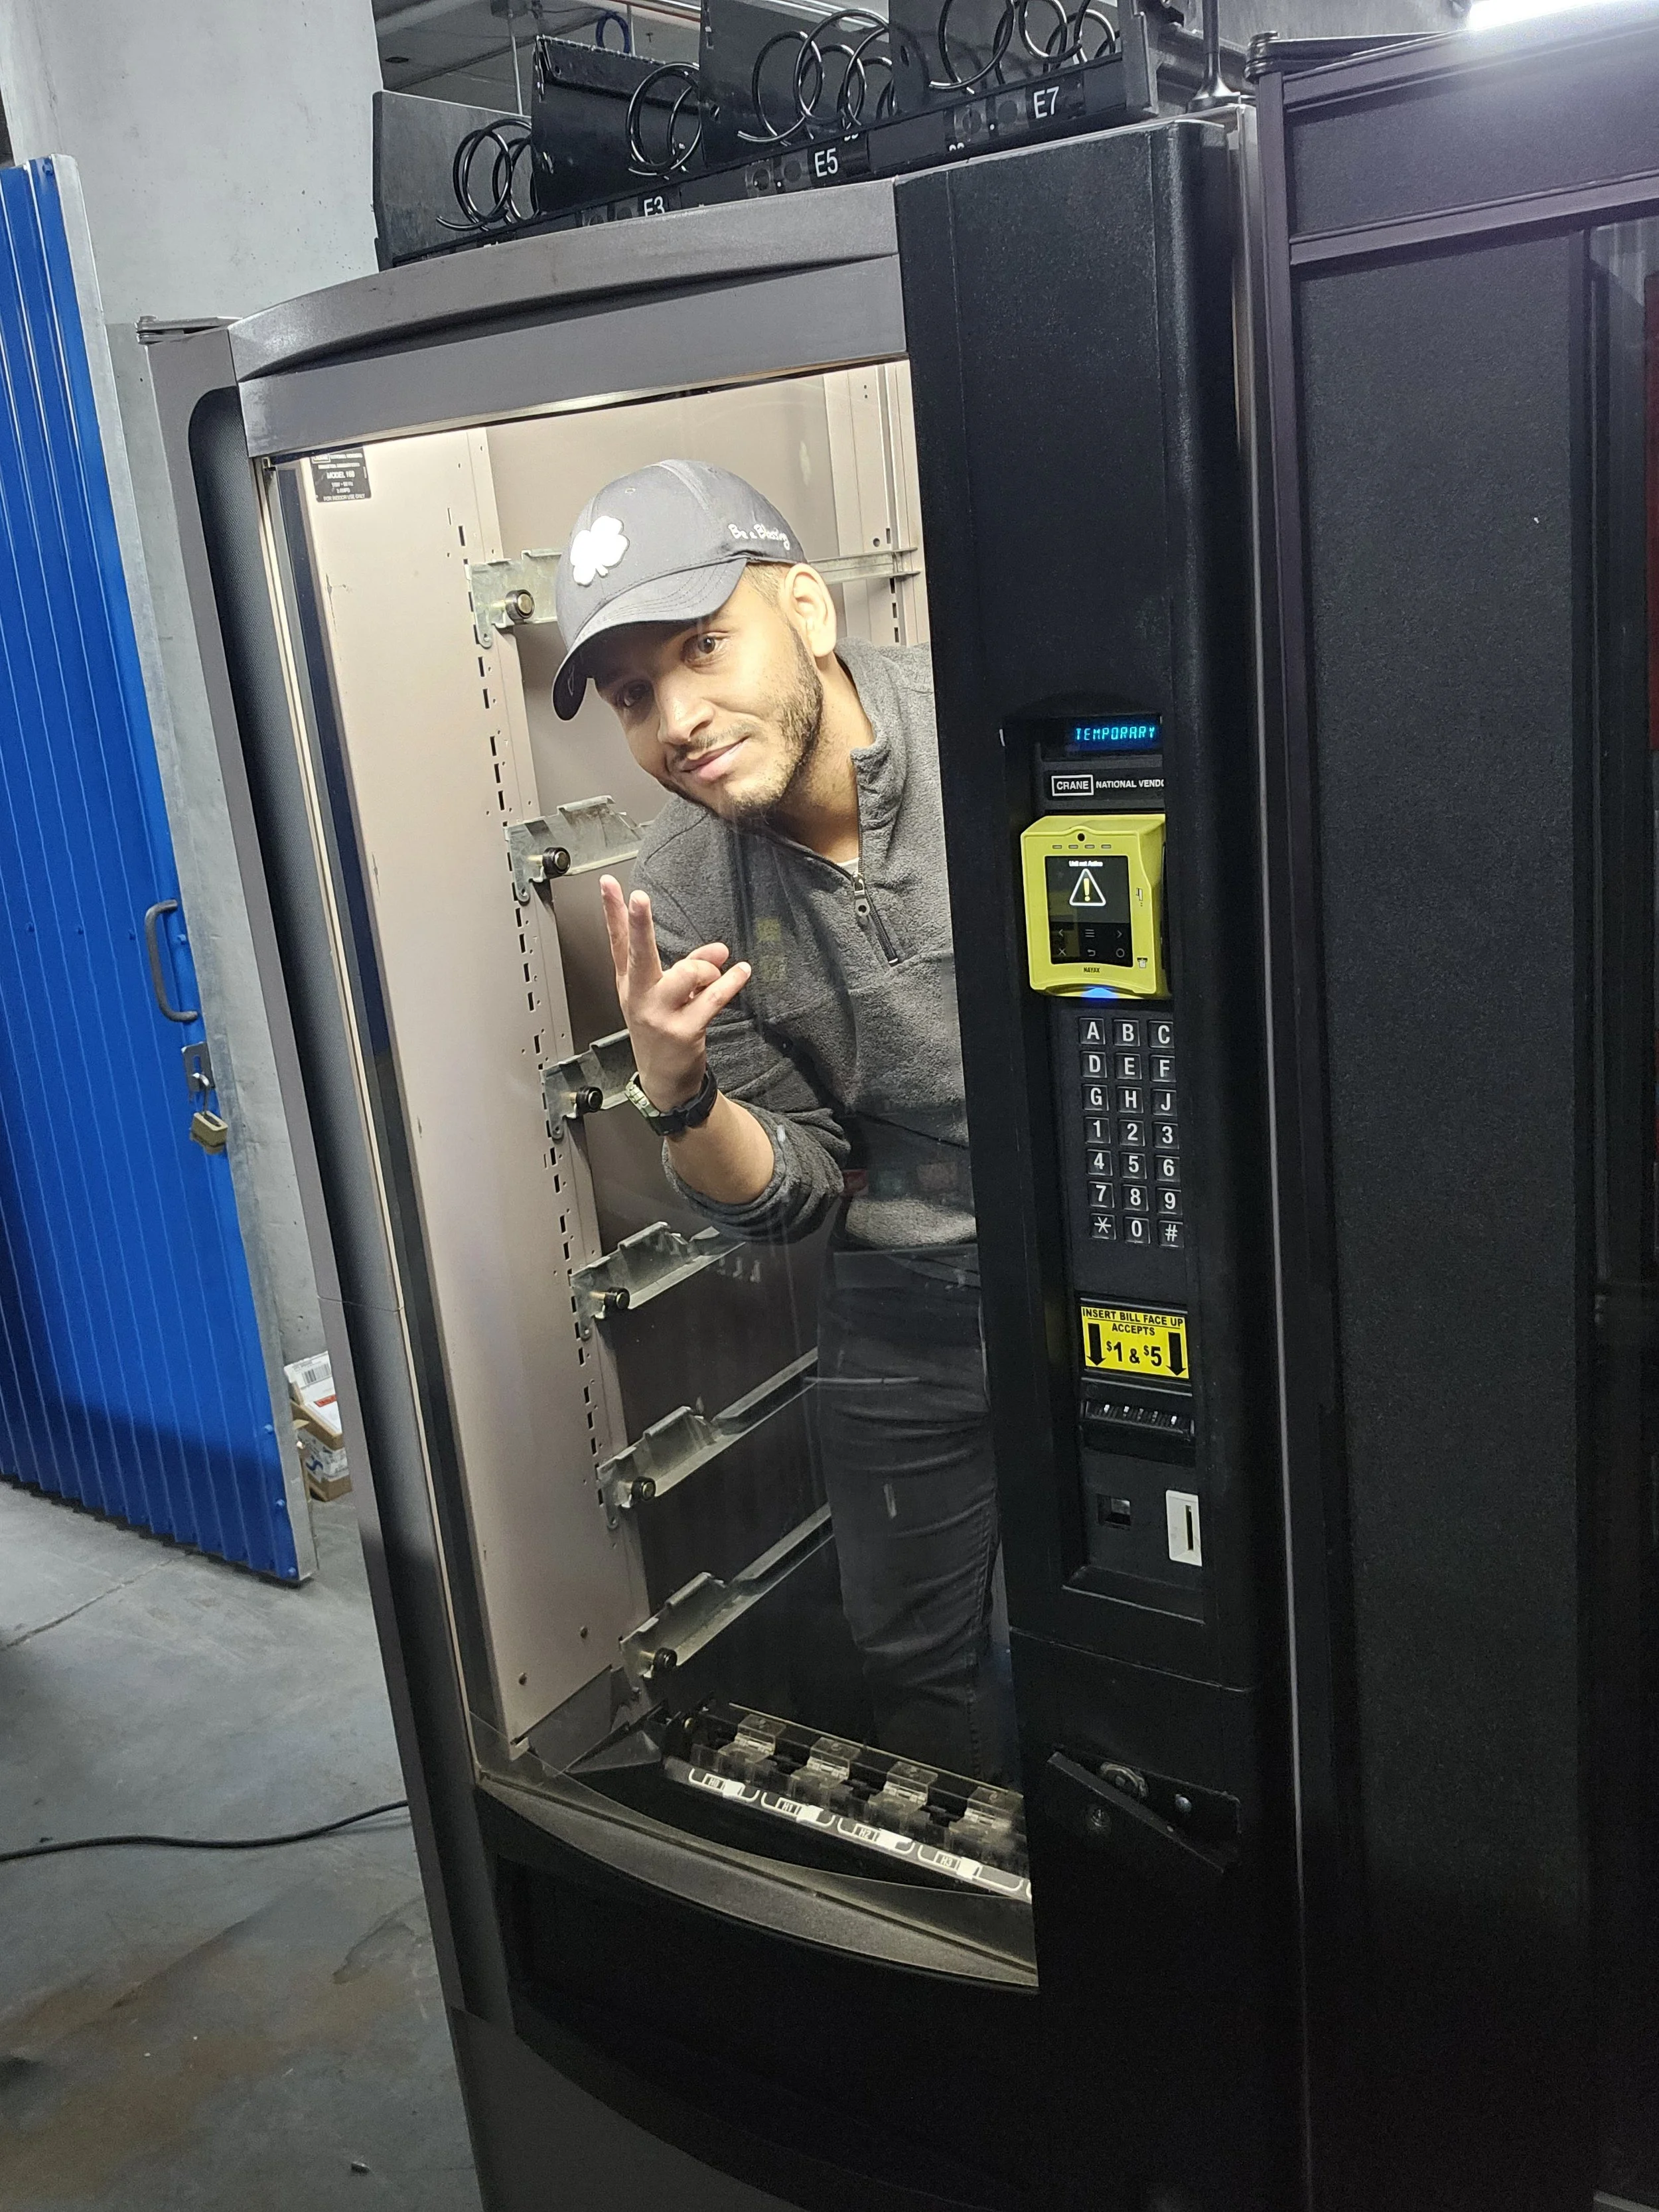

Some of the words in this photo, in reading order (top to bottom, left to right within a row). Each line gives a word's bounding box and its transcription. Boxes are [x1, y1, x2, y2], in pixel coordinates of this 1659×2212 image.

[1033, 86, 1059, 119] E7
[814, 147, 838, 177] E5
[1076, 726, 1155, 741] TEMPORARY
[1056, 780, 1089, 790] CRANE
[1096, 780, 1137, 788] NATIONAL
[1086, 1021, 1100, 1040] A
[1122, 1023, 1134, 1042] B
[1158, 1025, 1170, 1044] C
[1089, 1055, 1101, 1072] D
[1124, 1057, 1135, 1075] E
[1159, 1059, 1170, 1078] F
[1090, 1087, 1102, 1106] G
[1125, 1090, 1137, 1108] H
[1161, 1093, 1171, 1111] J
[1093, 1120, 1101, 1138] 1
[1127, 1123, 1138, 1141] 2
[1162, 1126, 1173, 1143] 3
[1094, 1152, 1105, 1170] 4
[1128, 1155, 1139, 1173] 5
[1163, 1159, 1175, 1177] 6
[1096, 1185, 1107, 1202] 7
[1130, 1188, 1141, 1206] 8
[1165, 1192, 1176, 1210] 9
[1131, 1220, 1142, 1237] 0
[1165, 1224, 1178, 1242] #
[1082, 1308, 1116, 1320] INSERT
[1119, 1311, 1141, 1323] BILL
[1143, 1314, 1167, 1325] FACE
[1170, 1317, 1183, 1327] UP
[1112, 1323, 1155, 1336] ACCEPTS
[1106, 1341, 1123, 1362] $1
[1129, 1348, 1141, 1364] &
[1143, 1345, 1162, 1366] $5
[782, 1801, 793, 1812] H1
[859, 1828, 870, 1839] H2
[940, 1856, 953, 1866] H3
